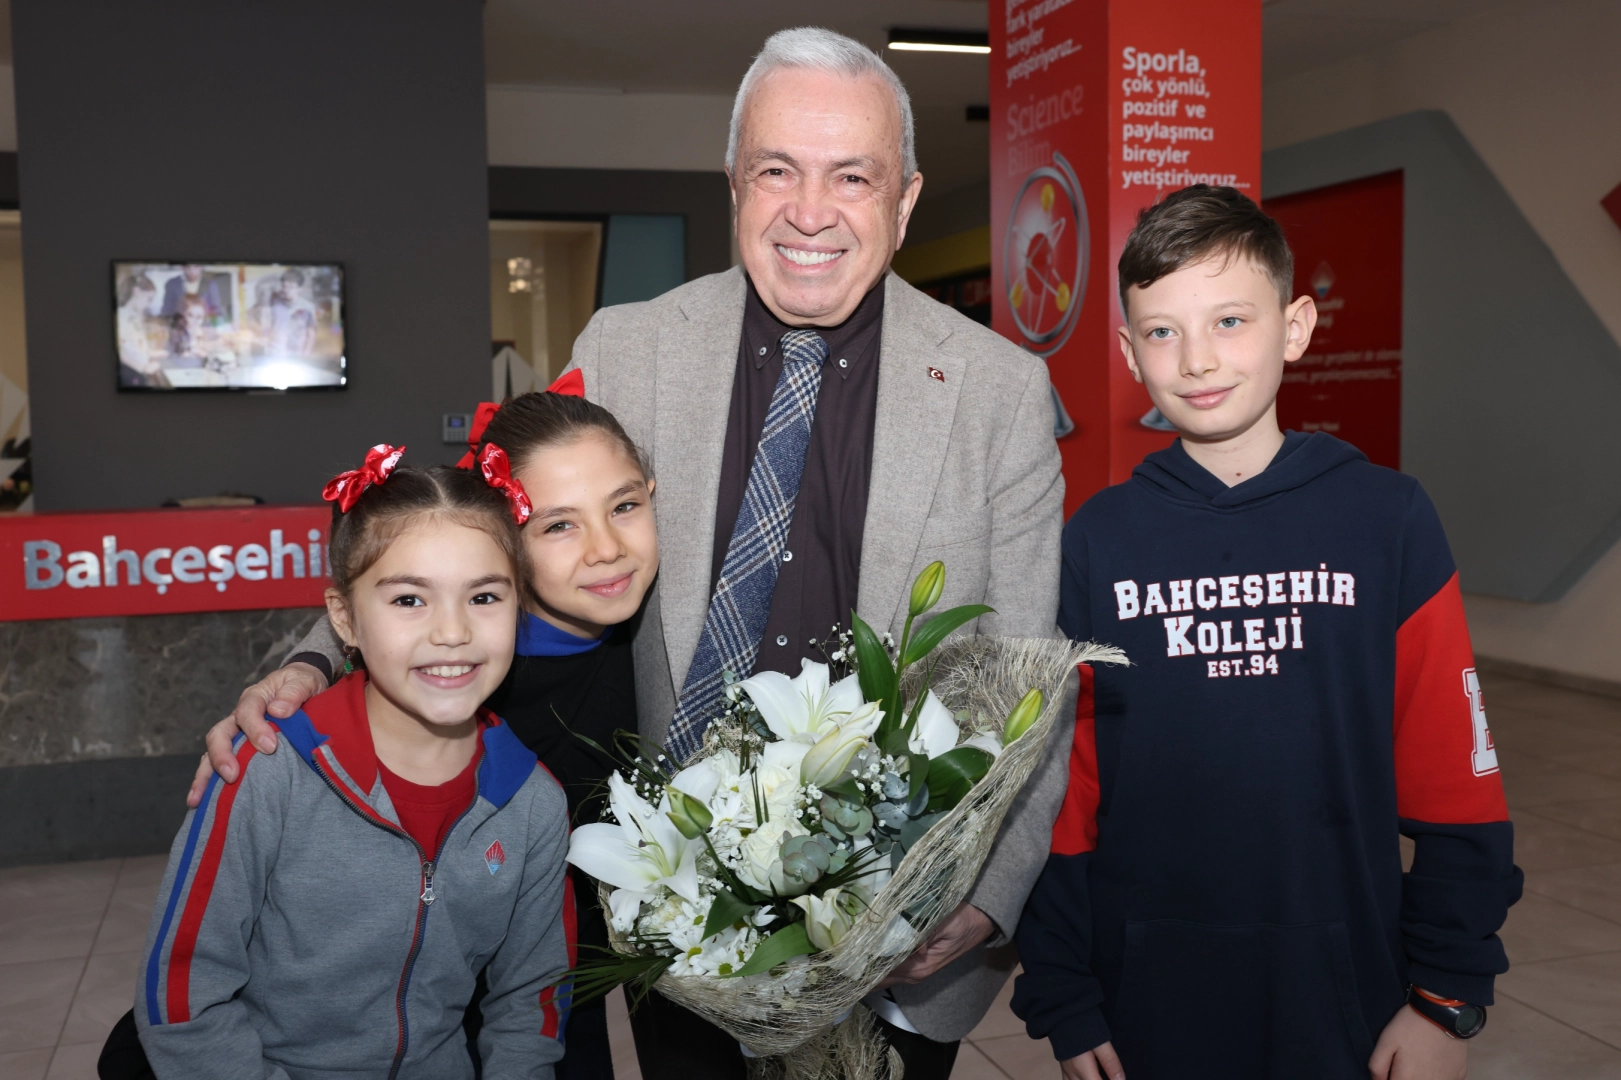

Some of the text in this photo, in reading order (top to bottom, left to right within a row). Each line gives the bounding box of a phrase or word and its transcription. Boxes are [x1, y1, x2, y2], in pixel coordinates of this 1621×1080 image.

[1122, 46, 1207, 77] Sporla,
[1122, 75, 1211, 99] çok yönlü,
[1007, 84, 1084, 142] Science
[1122, 98, 1207, 120] pozitif ve
[1122, 120, 1214, 144] paylaşımcı
[1122, 143, 1191, 168] bireyler
[23, 529, 333, 595] Bahçeşehi
[1113, 562, 1356, 621] BAHÇEŞEHİR
[1163, 607, 1304, 657] KOLEJİ
[1207, 654, 1279, 678] EST.94
